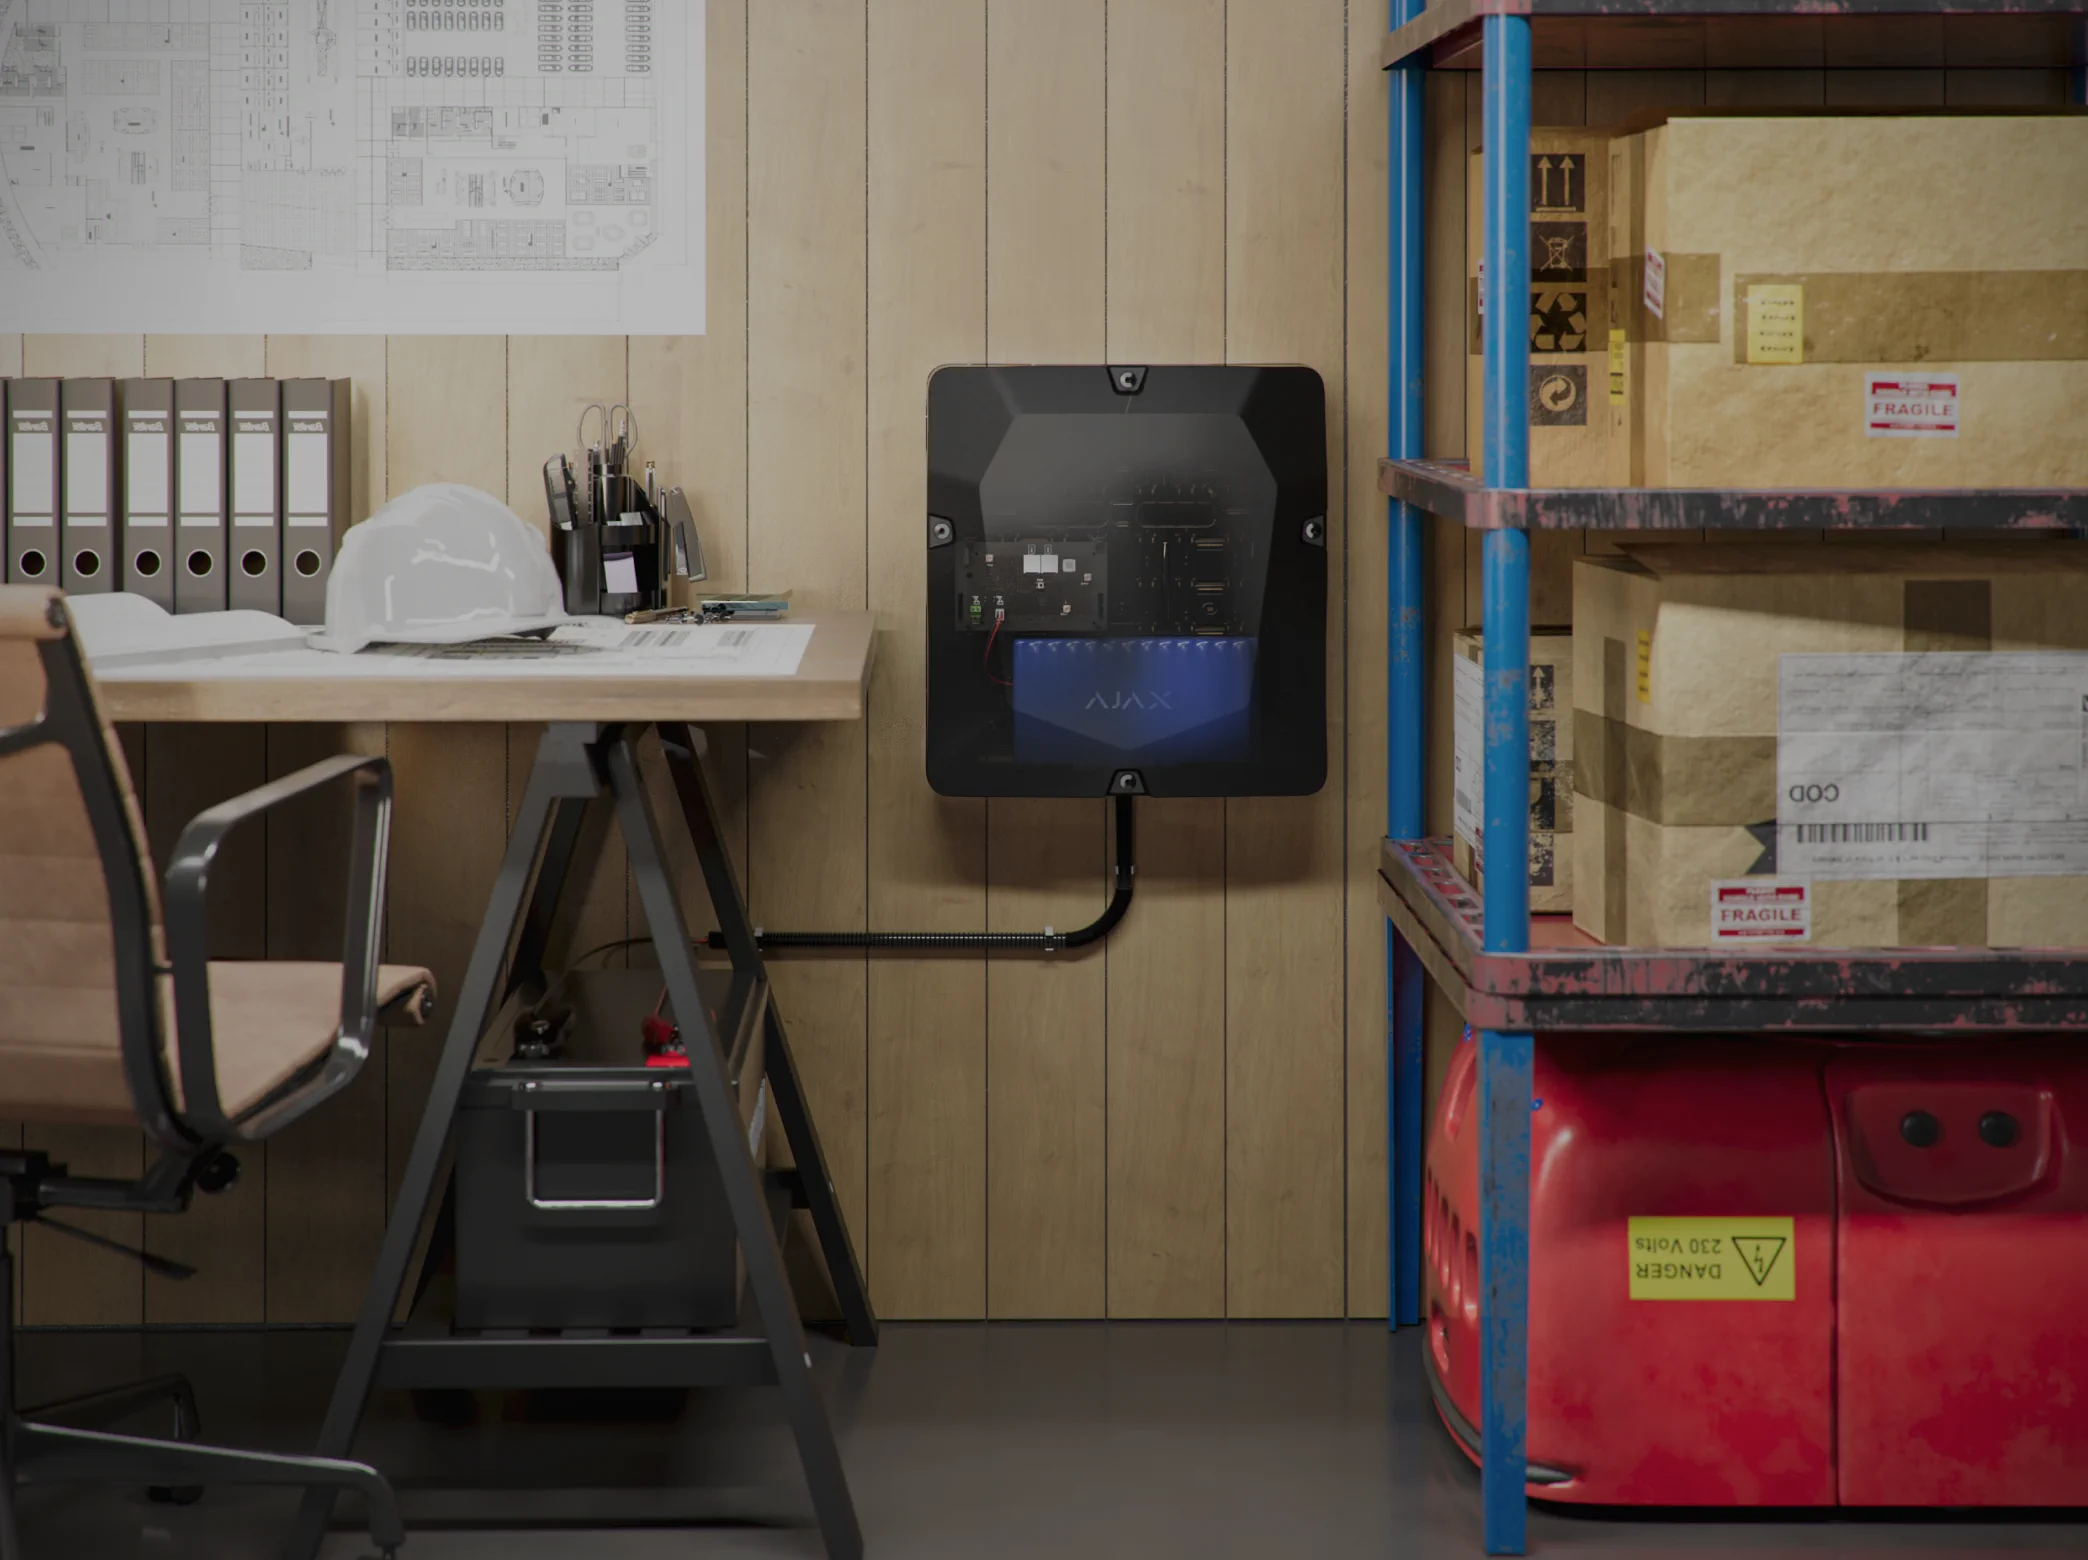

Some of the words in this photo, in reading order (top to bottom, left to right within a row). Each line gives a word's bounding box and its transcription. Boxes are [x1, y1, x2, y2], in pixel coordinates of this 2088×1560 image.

[1873, 402, 1955, 417] FRAGILE
[1084, 689, 1173, 710] AJAX
[1788, 783, 1840, 803] COD
[1720, 907, 1802, 922] FRAGILE
[1635, 1237, 1684, 1255] Volts
[1689, 1237, 1722, 1255] 230
[1636, 1262, 1722, 1280] DANGER
